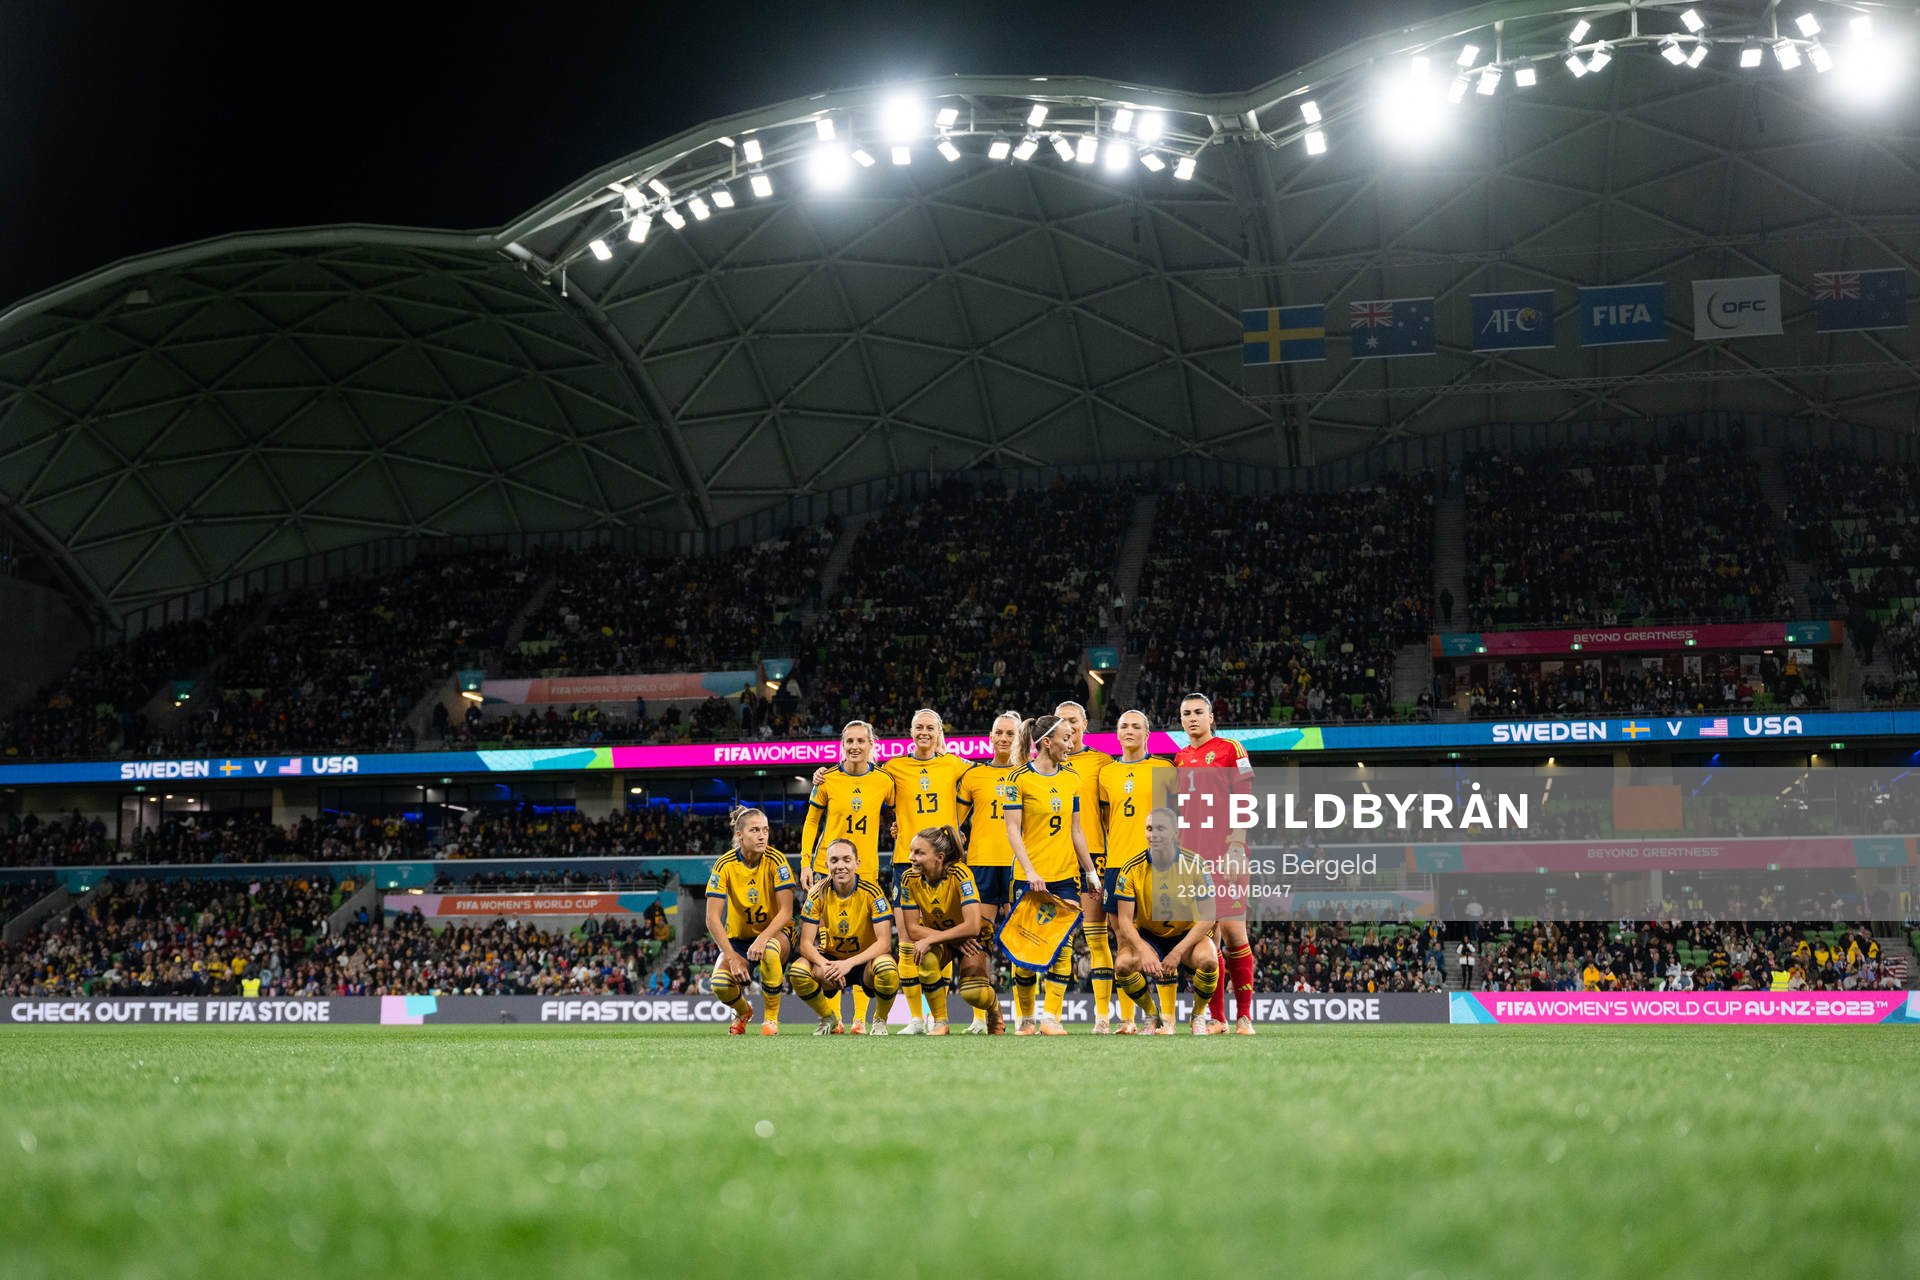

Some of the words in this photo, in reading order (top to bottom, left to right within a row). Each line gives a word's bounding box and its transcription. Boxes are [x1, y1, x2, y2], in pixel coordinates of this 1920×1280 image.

[1593, 303, 1651, 327] FIFA
[1722, 300, 1767, 313] OFC
[1481, 307, 1538, 335] AFC
[1573, 632, 1621, 643] BEYOND
[1492, 721, 1606, 743] SWEDEN
[1666, 721, 1683, 737] V
[1743, 716, 1802, 736] USA
[714, 747, 752, 762] FIFA
[752, 744, 837, 761] WOMEN'S
[120, 760, 210, 779] SWEDEN
[253, 760, 268, 774] V
[312, 756, 359, 773] USA
[1187, 770, 1196, 792] 1
[915, 792, 939, 814] 13
[991, 800, 1004, 819] 1
[1123, 797, 1135, 817] 6
[846, 814, 867, 834] 14
[1050, 815, 1062, 836] 9
[1587, 849, 1639, 859] BEYOND
[456, 901, 479, 910] FIFA
[480, 900, 531, 910] WOMEN'S
[534, 899, 572, 909] WORLD
[575, 899, 598, 909] CUP
[744, 906, 767, 925] 16
[833, 936, 860, 953] 23
[11, 1002, 91, 1022] CHECK
[95, 1002, 146, 1022] OUT
[149, 1002, 198, 1022] THE
[258, 1002, 330, 1022] STORE
[541, 1001, 736, 1021] FIFASTORE.CO
[1293, 998, 1380, 1021] STORE
[1496, 1001, 1536, 1016] FIFA
[1537, 1001, 1628, 1017] WOMEN'S
[1631, 1001, 1700, 1016] WORLD
[1703, 1001, 1742, 1016] CUP
